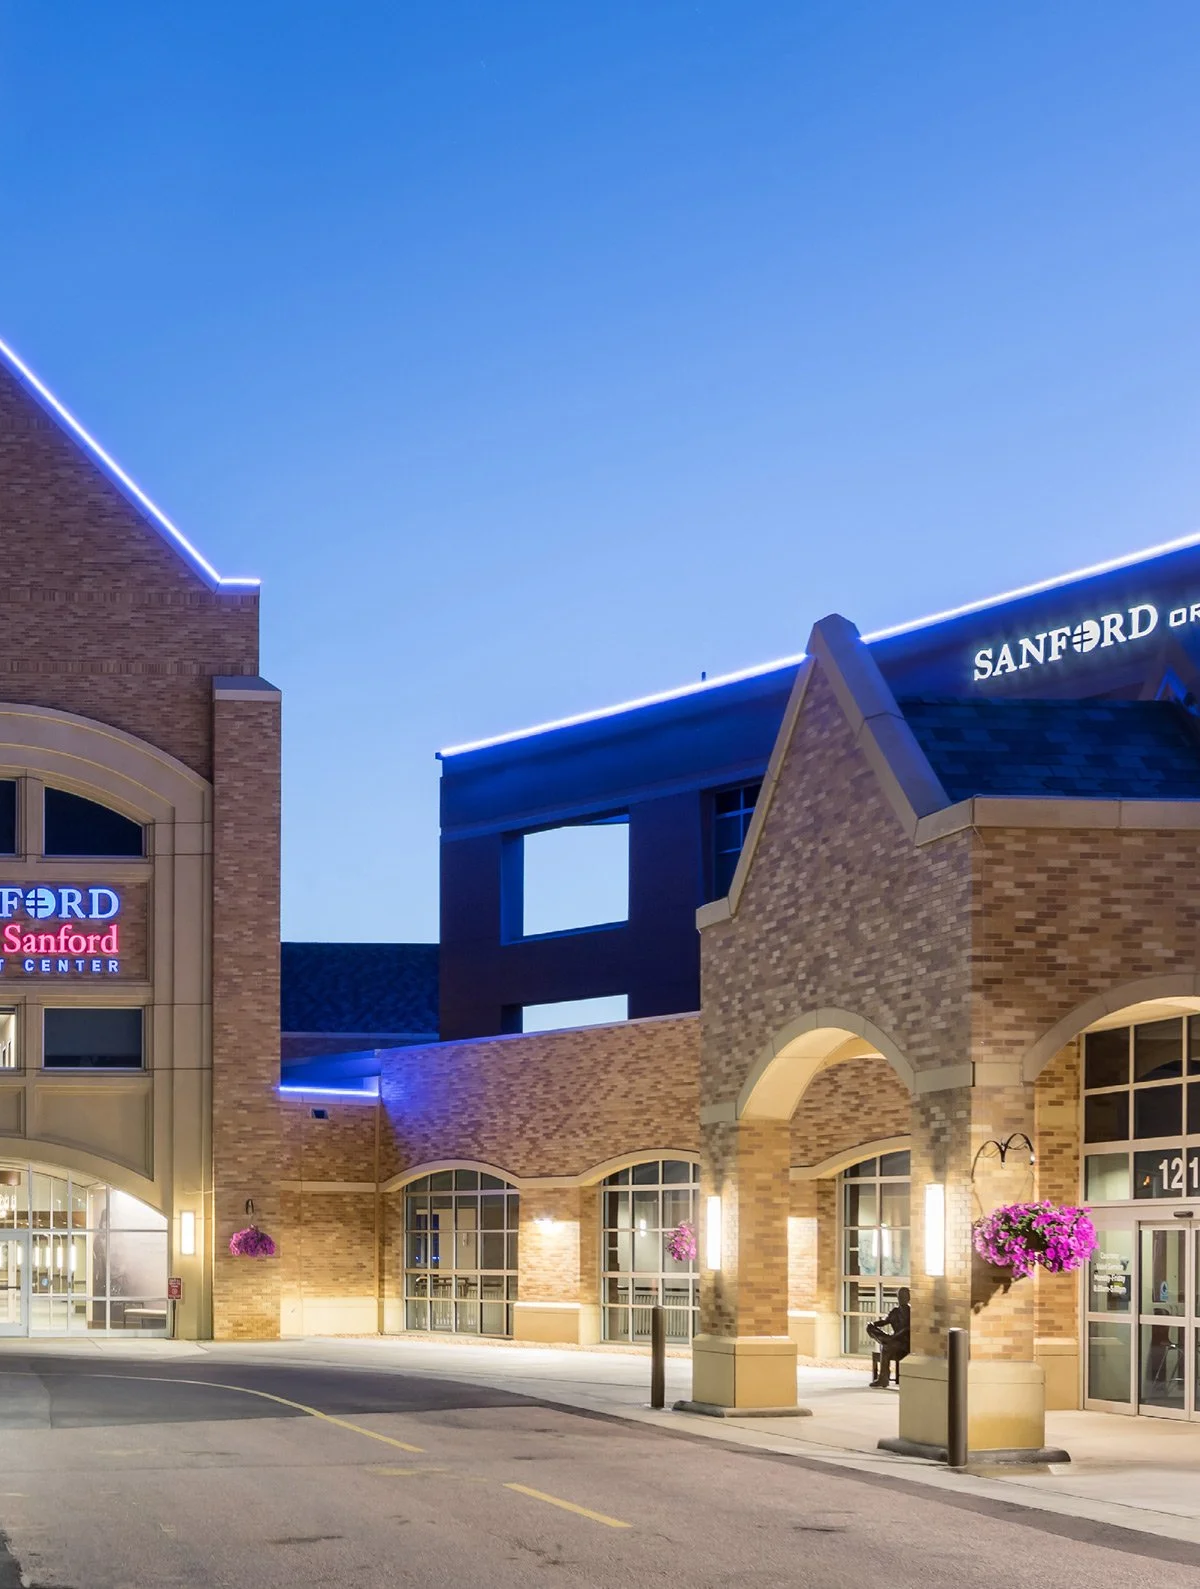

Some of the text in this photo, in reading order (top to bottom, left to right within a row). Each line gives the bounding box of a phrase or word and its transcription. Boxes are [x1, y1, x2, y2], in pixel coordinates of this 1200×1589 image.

[973, 604, 1159, 681] SANFORD
[3, 923, 119, 954] Sanford
[24, 959, 119, 973] CENTER
